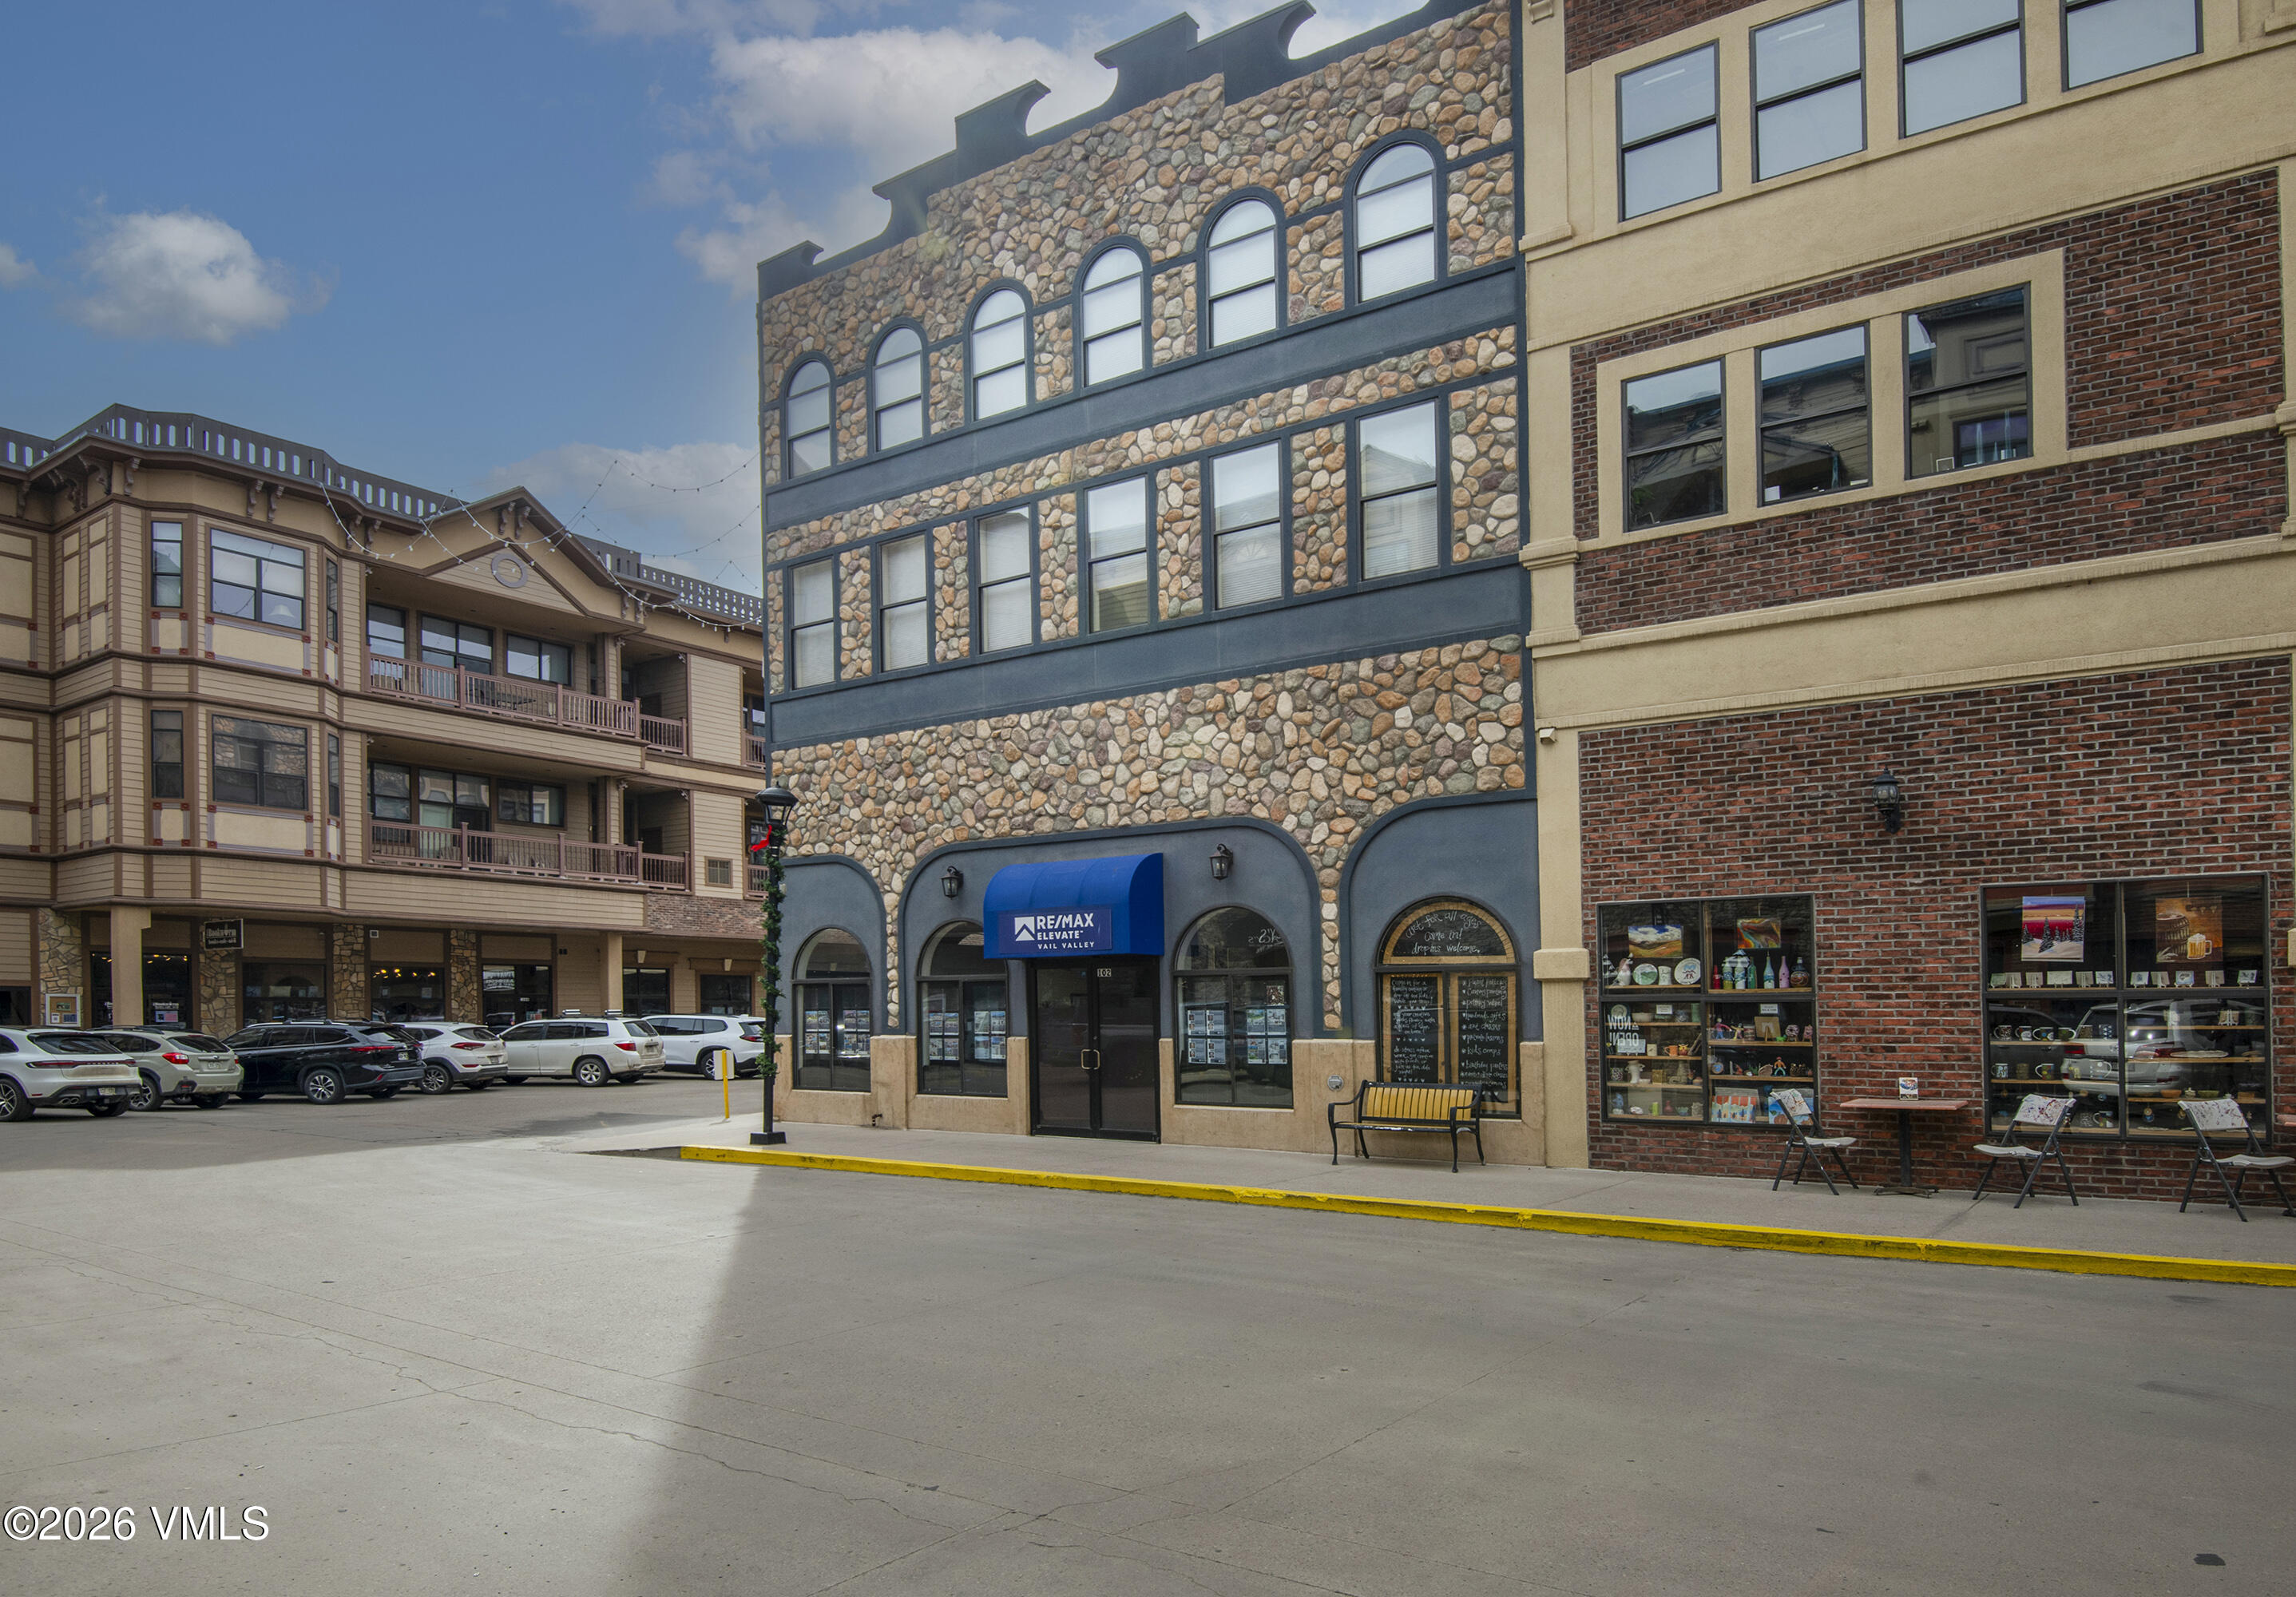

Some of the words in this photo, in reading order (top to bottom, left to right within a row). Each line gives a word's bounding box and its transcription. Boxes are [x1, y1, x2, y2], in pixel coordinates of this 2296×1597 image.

[1037, 913, 1094, 929] RE/MAX
[1445, 911, 1457, 921] all
[1037, 930, 1080, 941] ELEVATE
[1467, 1044, 1482, 1055] kids
